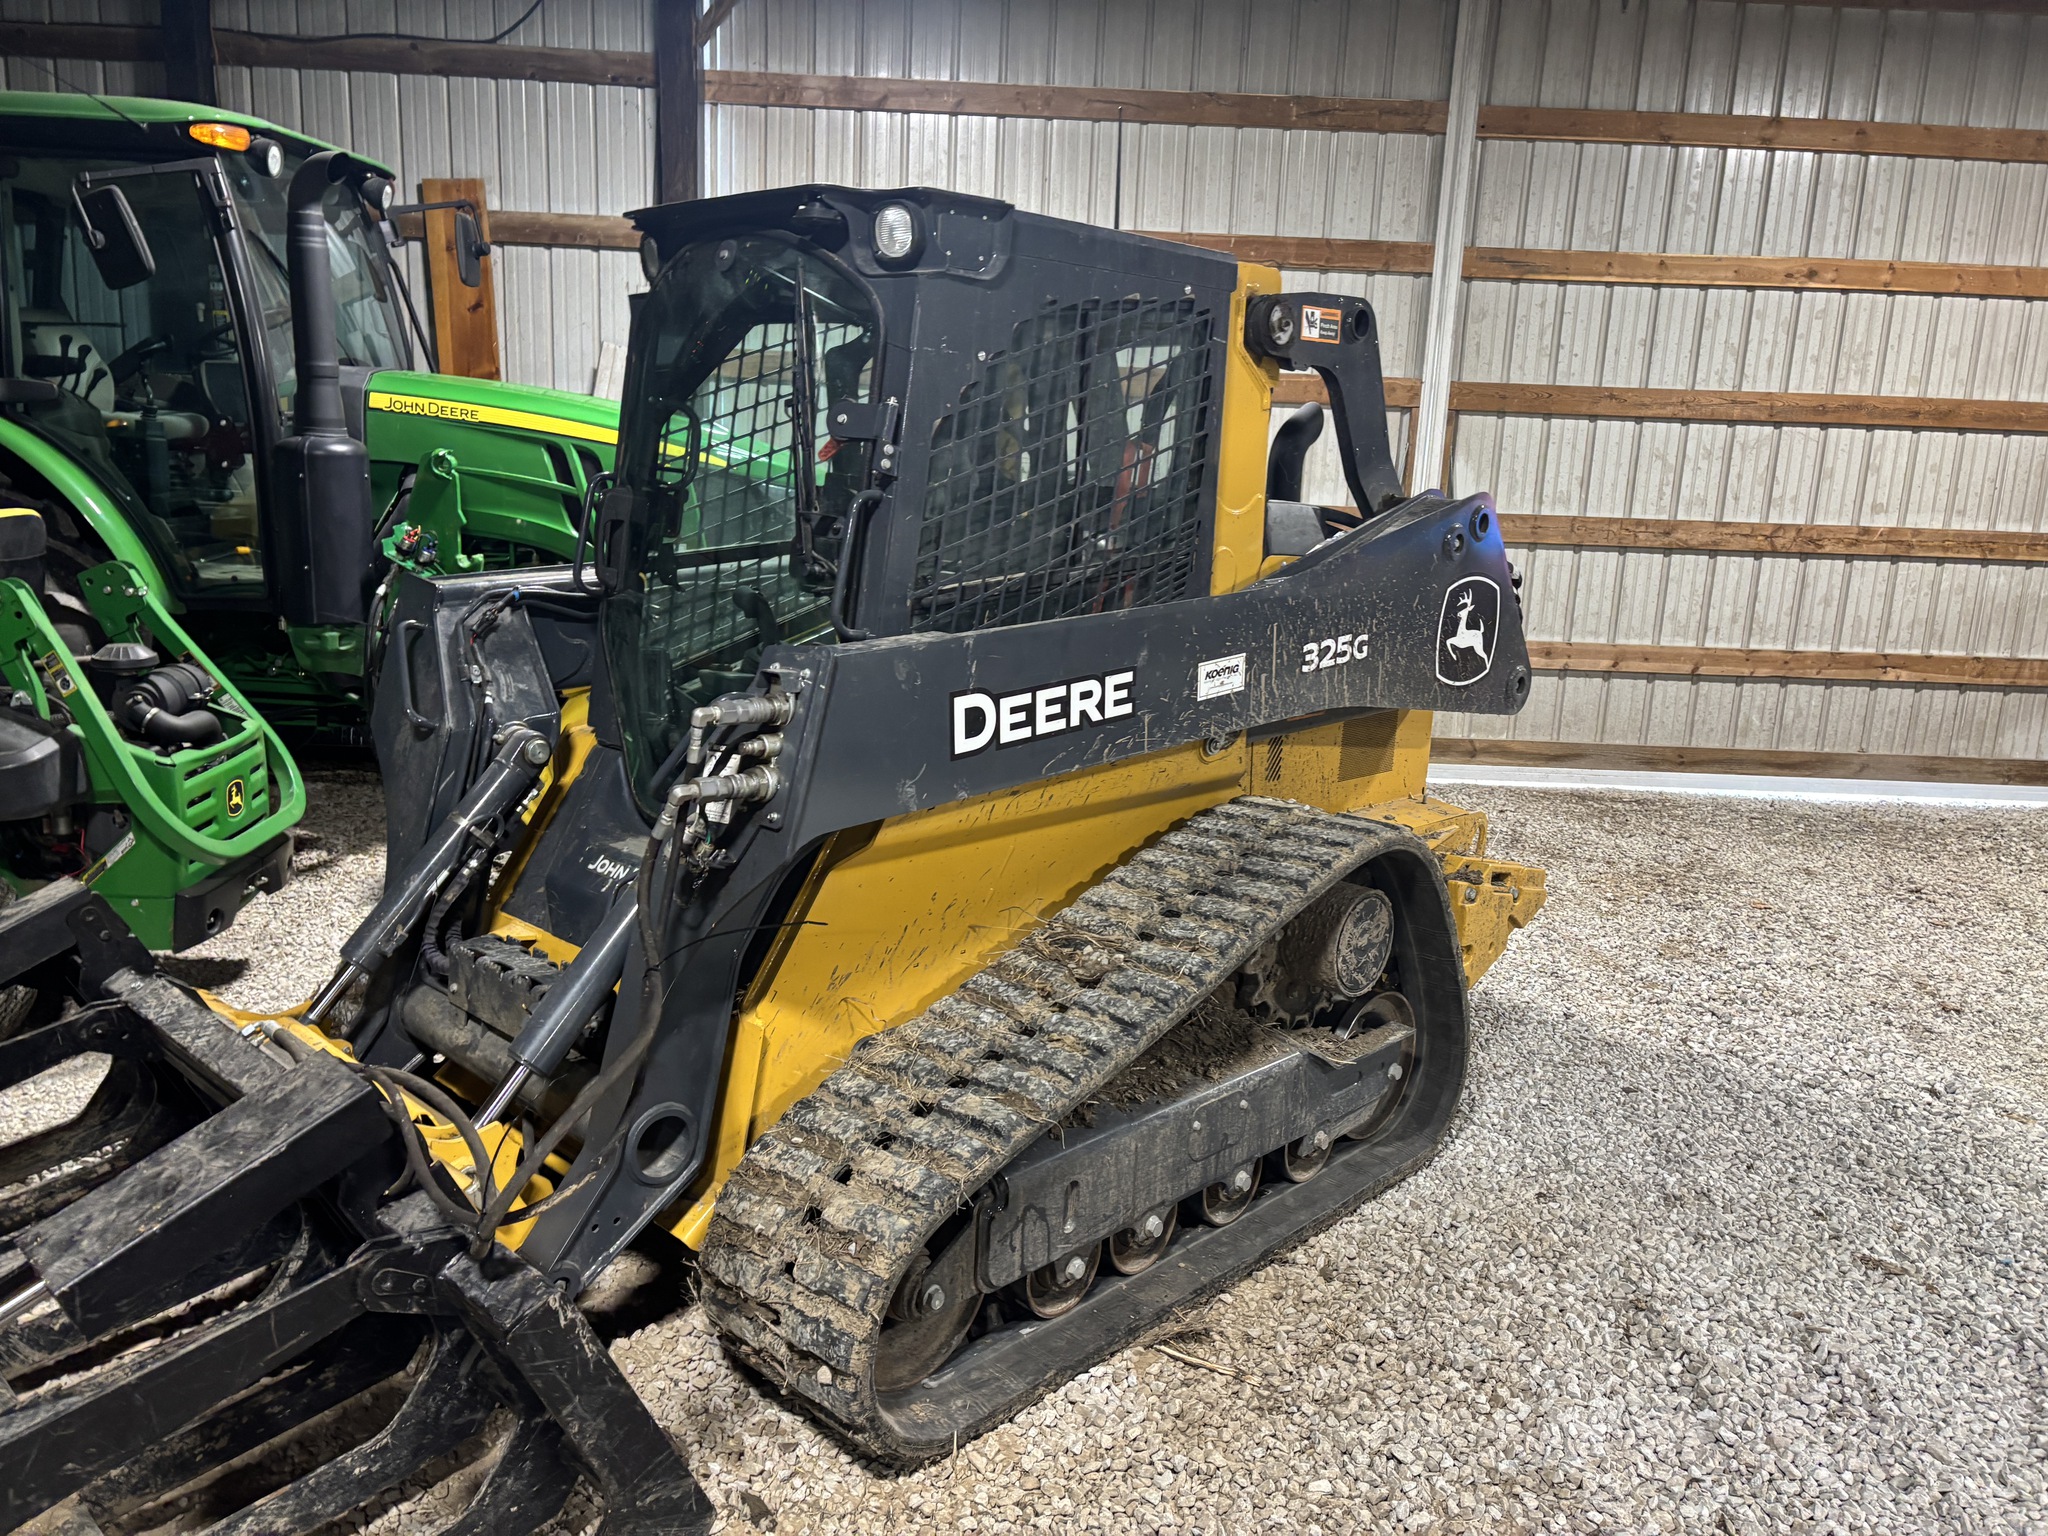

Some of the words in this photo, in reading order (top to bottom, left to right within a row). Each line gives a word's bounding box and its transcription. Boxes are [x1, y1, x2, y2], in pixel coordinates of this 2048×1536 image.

[384, 397, 425, 413] JOHN
[428, 402, 479, 420] DEERE
[1301, 633, 1369, 673] 325G
[953, 671, 1134, 755] DEERE
[587, 854, 630, 880] JOHN
